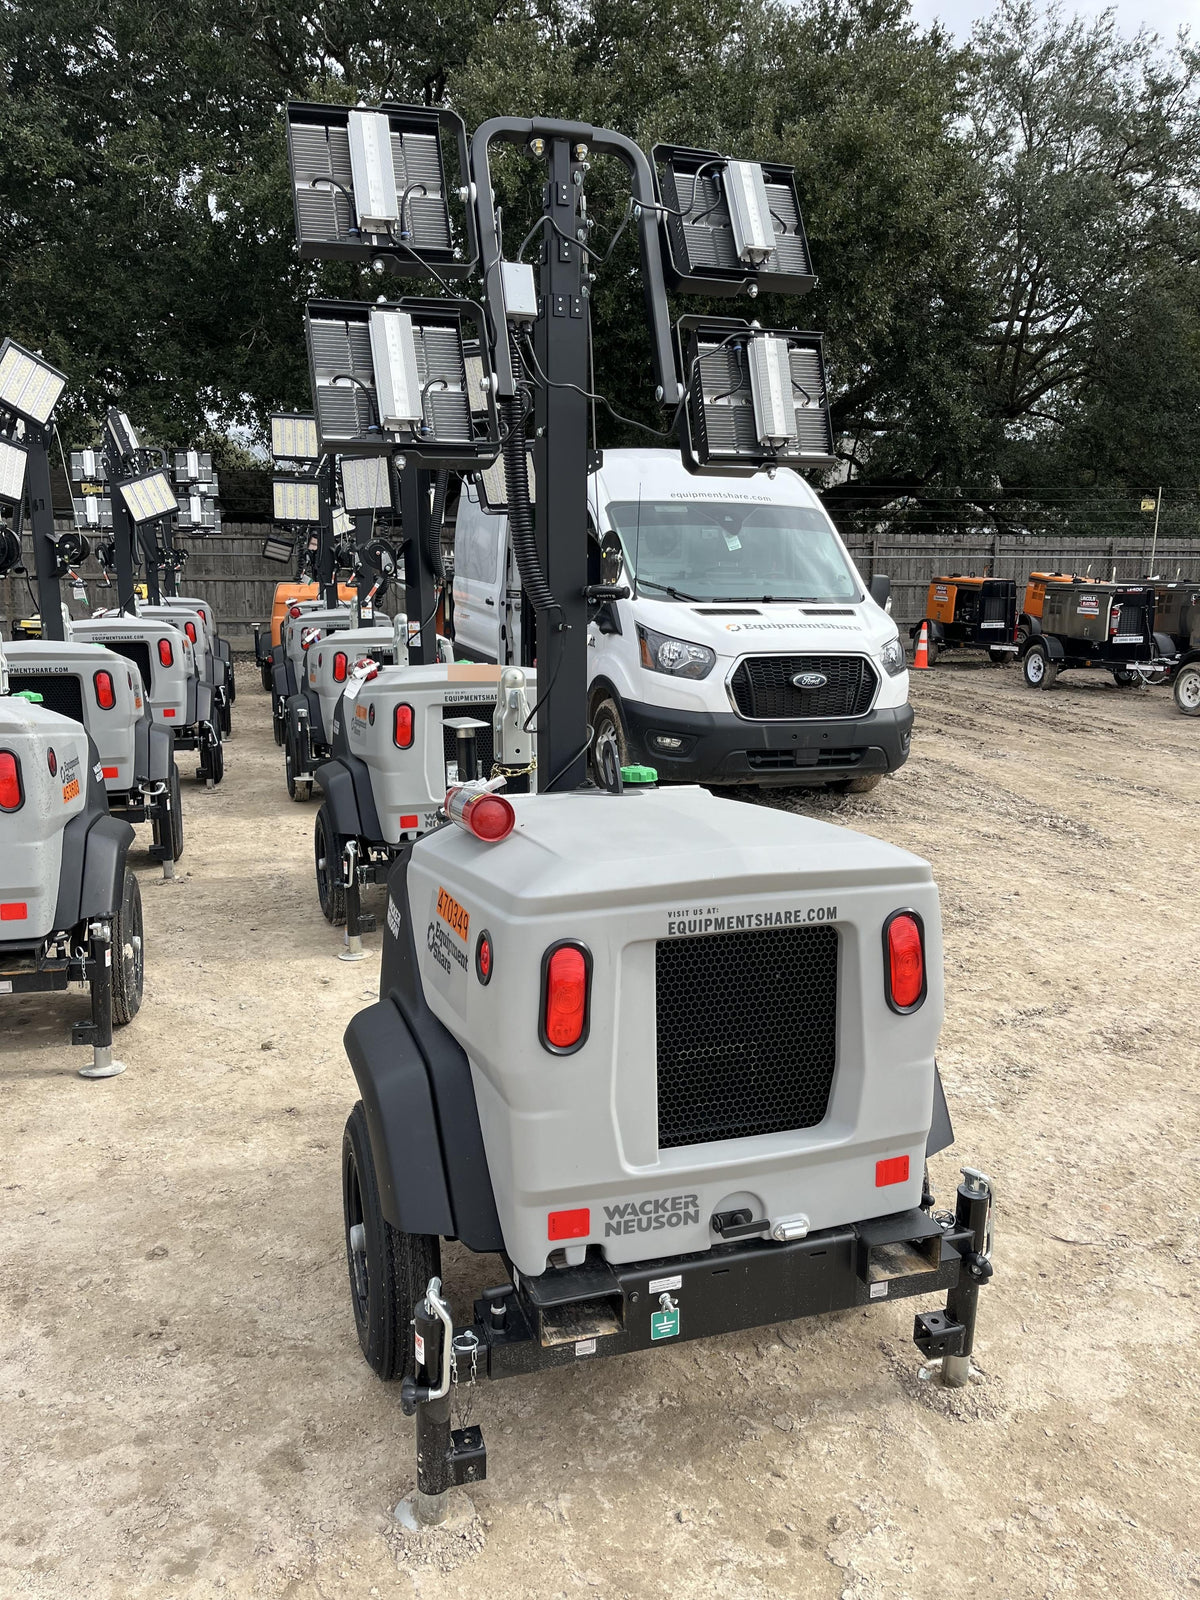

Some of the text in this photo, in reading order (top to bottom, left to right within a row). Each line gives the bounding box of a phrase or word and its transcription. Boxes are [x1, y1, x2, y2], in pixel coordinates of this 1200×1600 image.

[670, 491, 773, 502] equipmentshare.com
[743, 622, 863, 631] EquipmentShare
[801, 675, 821, 685] Ford
[437, 890, 469, 943] 470349
[667, 907, 720, 918] VISIT US AT:
[668, 906, 837, 935] EQUIPMENTSHARE.COM
[433, 940, 452, 975] Share
[435, 920, 469, 973] Equipment
[602, 1194, 700, 1221] WACKER
[604, 1208, 700, 1238] NEUSON
